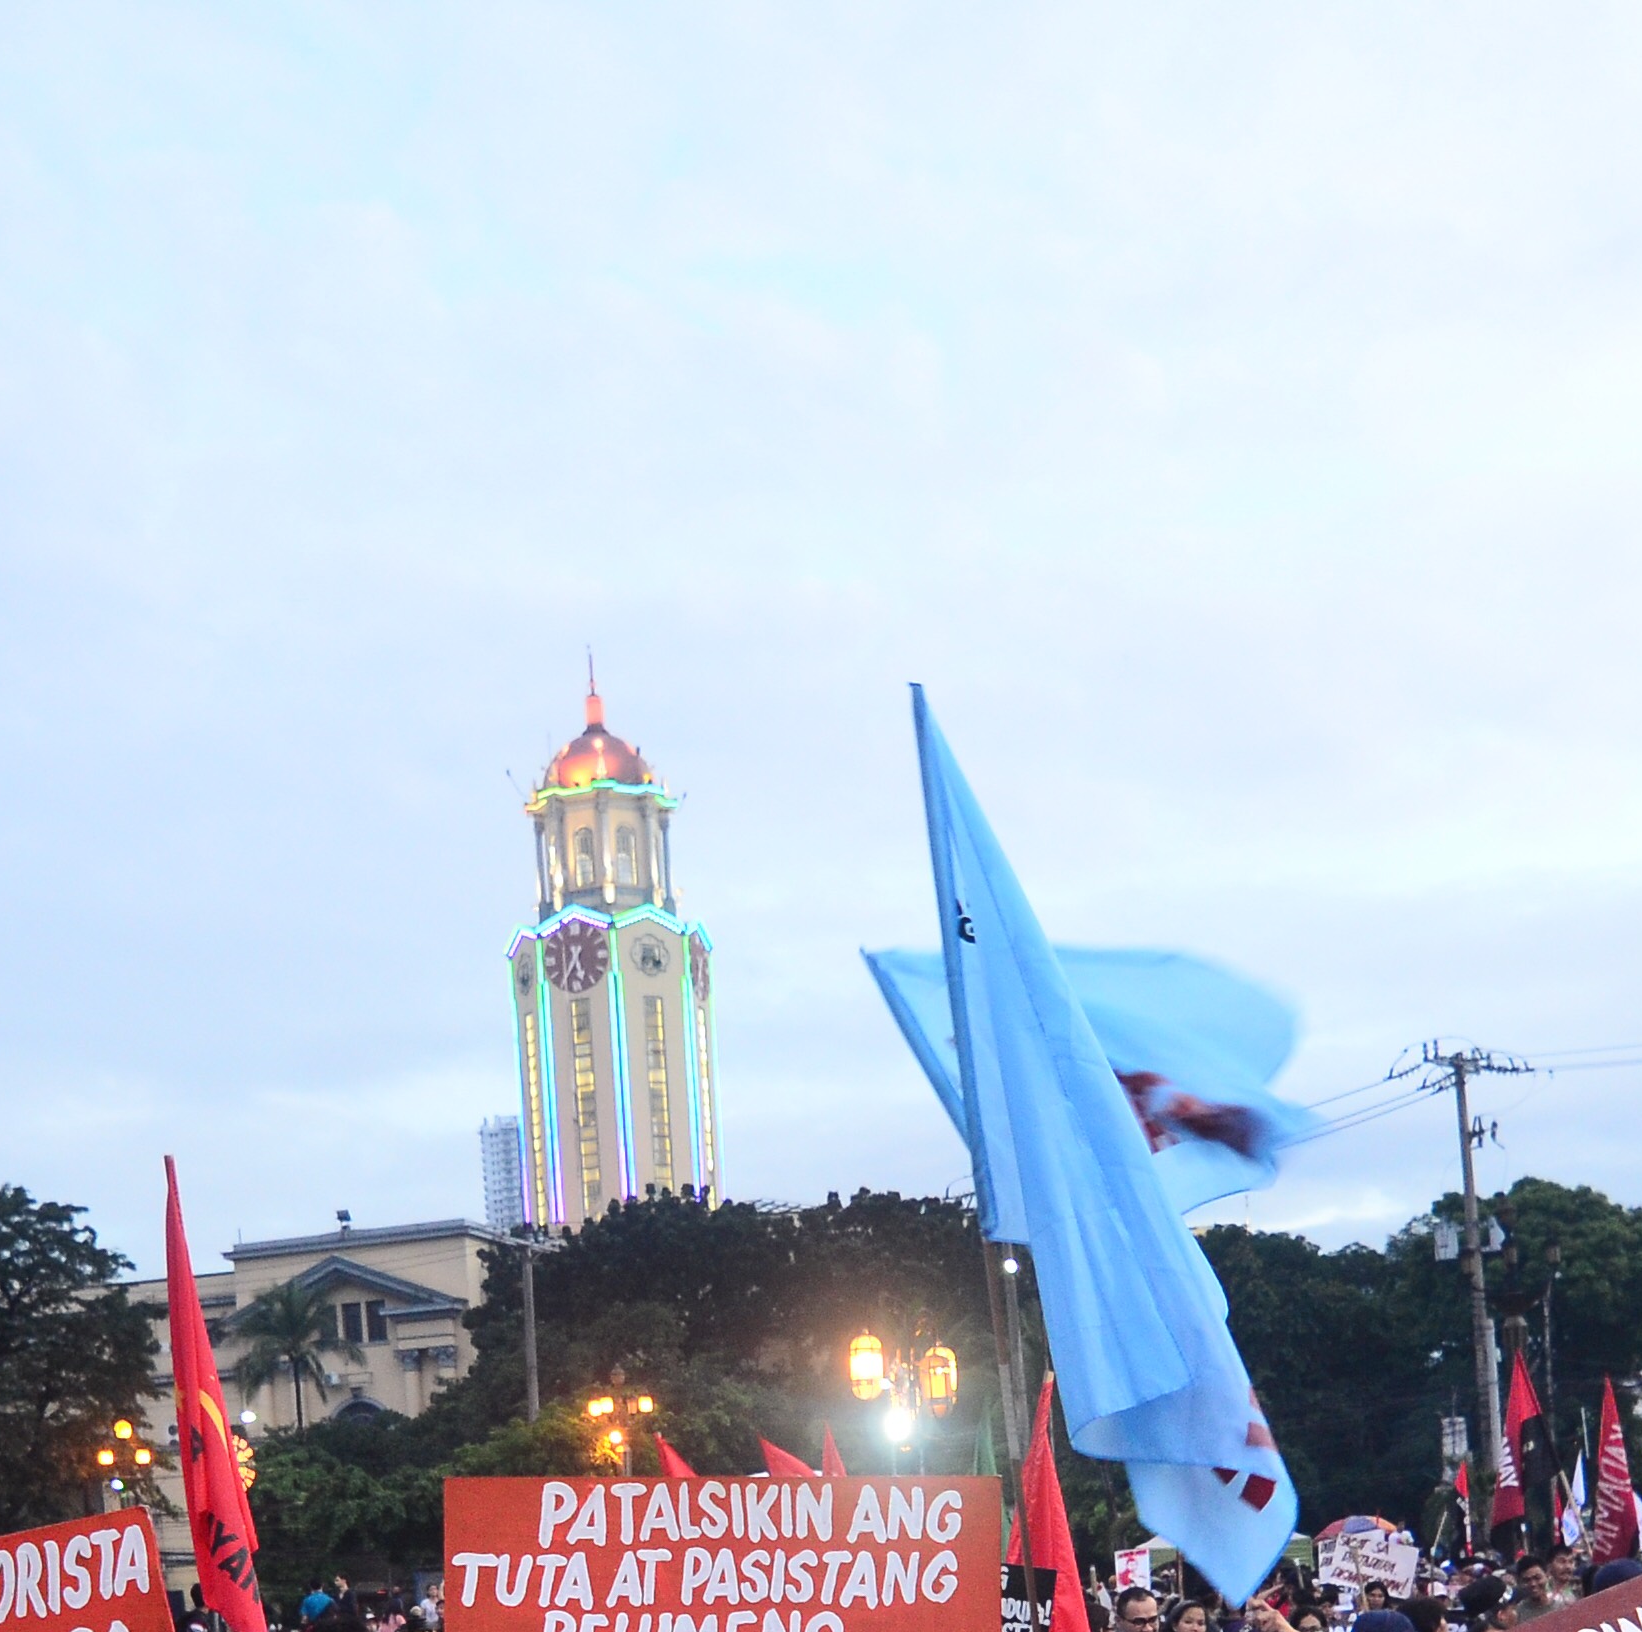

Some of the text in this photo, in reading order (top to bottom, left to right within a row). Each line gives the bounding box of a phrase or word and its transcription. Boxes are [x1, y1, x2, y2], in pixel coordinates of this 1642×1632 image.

[538, 1482, 963, 1550] PATALSIKIN ANG
[451, 1551, 594, 1610] TUTA
[605, 1548, 673, 1607] AT
[680, 1547, 959, 1611] PASISTANG
